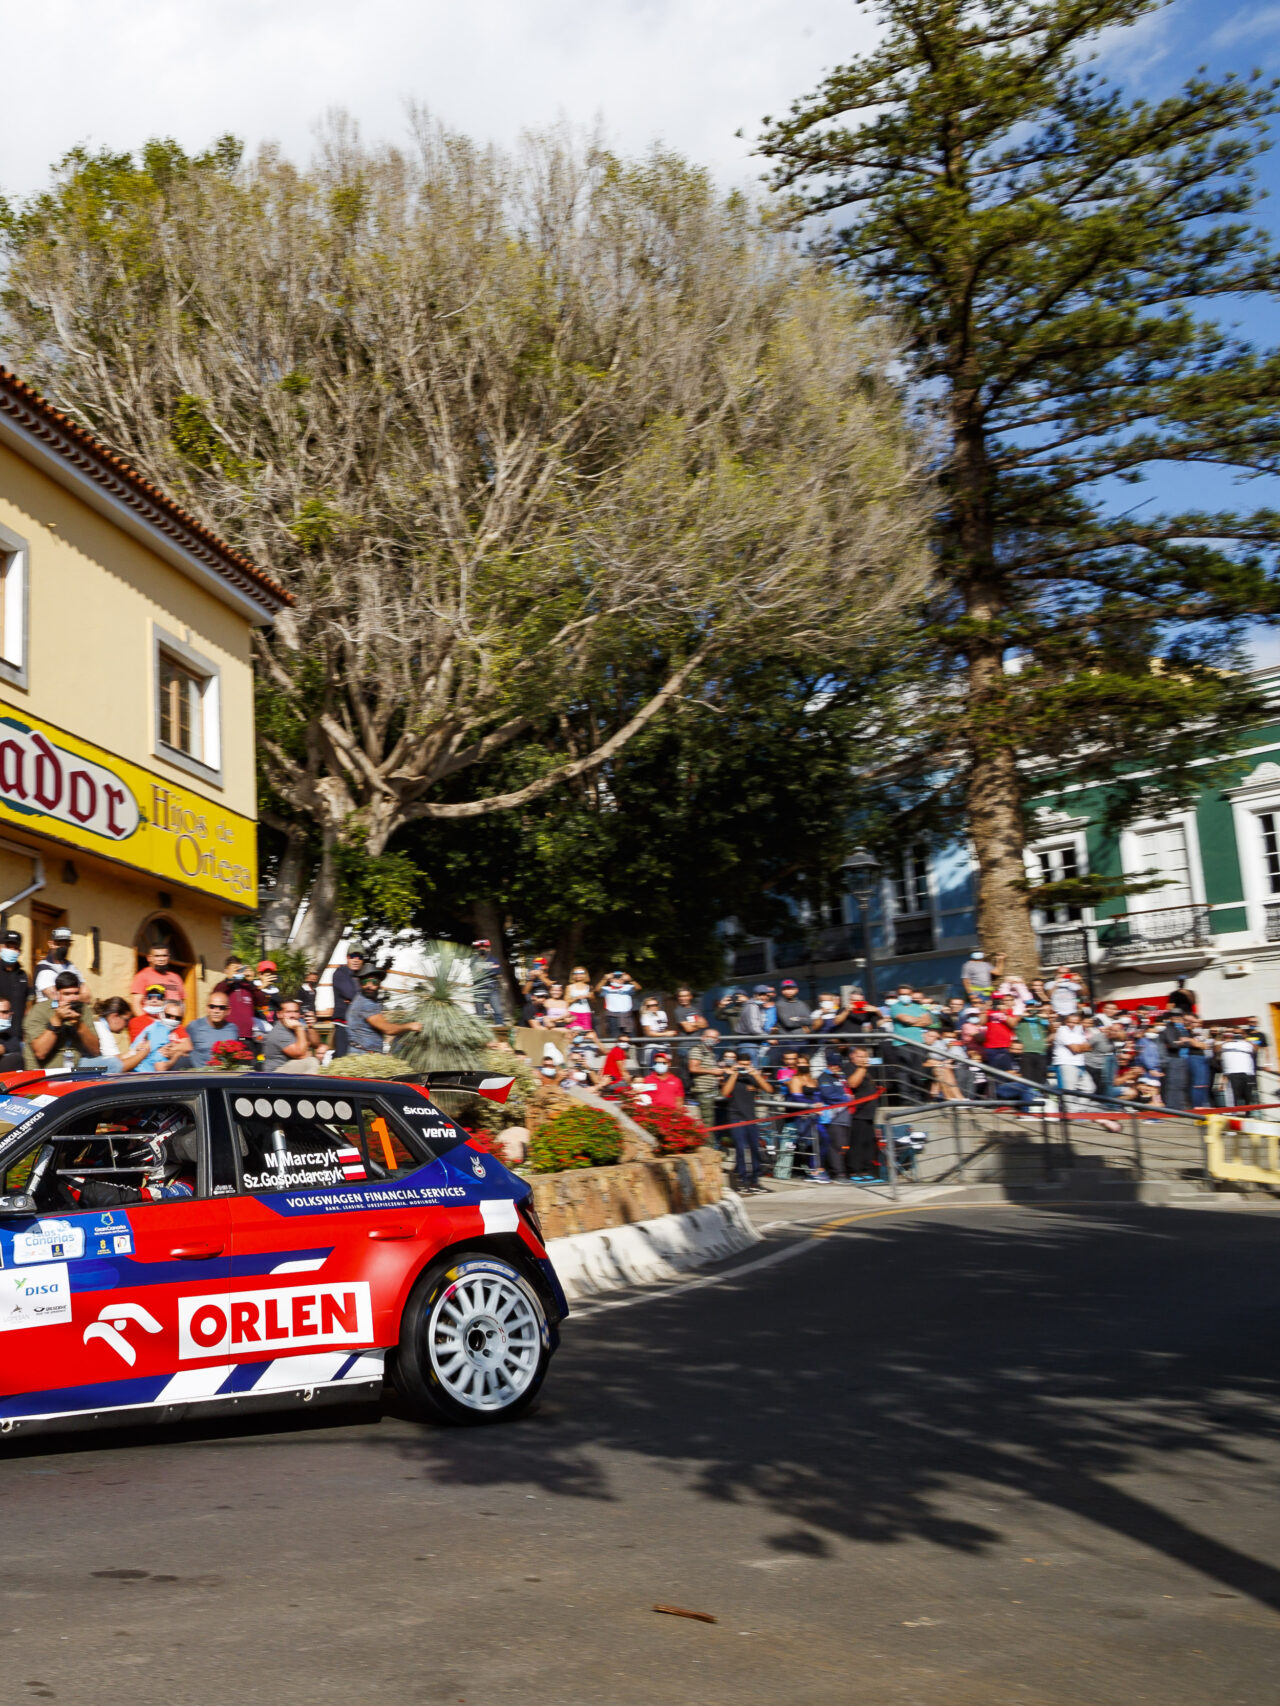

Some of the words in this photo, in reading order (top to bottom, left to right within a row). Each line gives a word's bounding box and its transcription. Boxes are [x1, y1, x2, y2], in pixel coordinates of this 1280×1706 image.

[150, 783, 209, 839] Hijos
[215, 819, 235, 844] de
[175, 834, 254, 894] Ortega
[403, 1105, 439, 1116] ŠKODA
[19, 1111, 45, 1135] SERVICES
[422, 1127, 457, 1138] verva
[370, 1117, 398, 1170] 1
[264, 1148, 339, 1168] MMarczyk
[243, 1166, 346, 1189] Sz.Gospodarczyk
[286, 1193, 362, 1208] VOLKSWAGEN
[363, 1188, 420, 1202] FINANCIAL
[421, 1186, 466, 1198] SERVICES
[25, 1233, 75, 1247] Canarias
[32, 1229, 56, 1238] Islas
[189, 1291, 359, 1348] ORLEN
